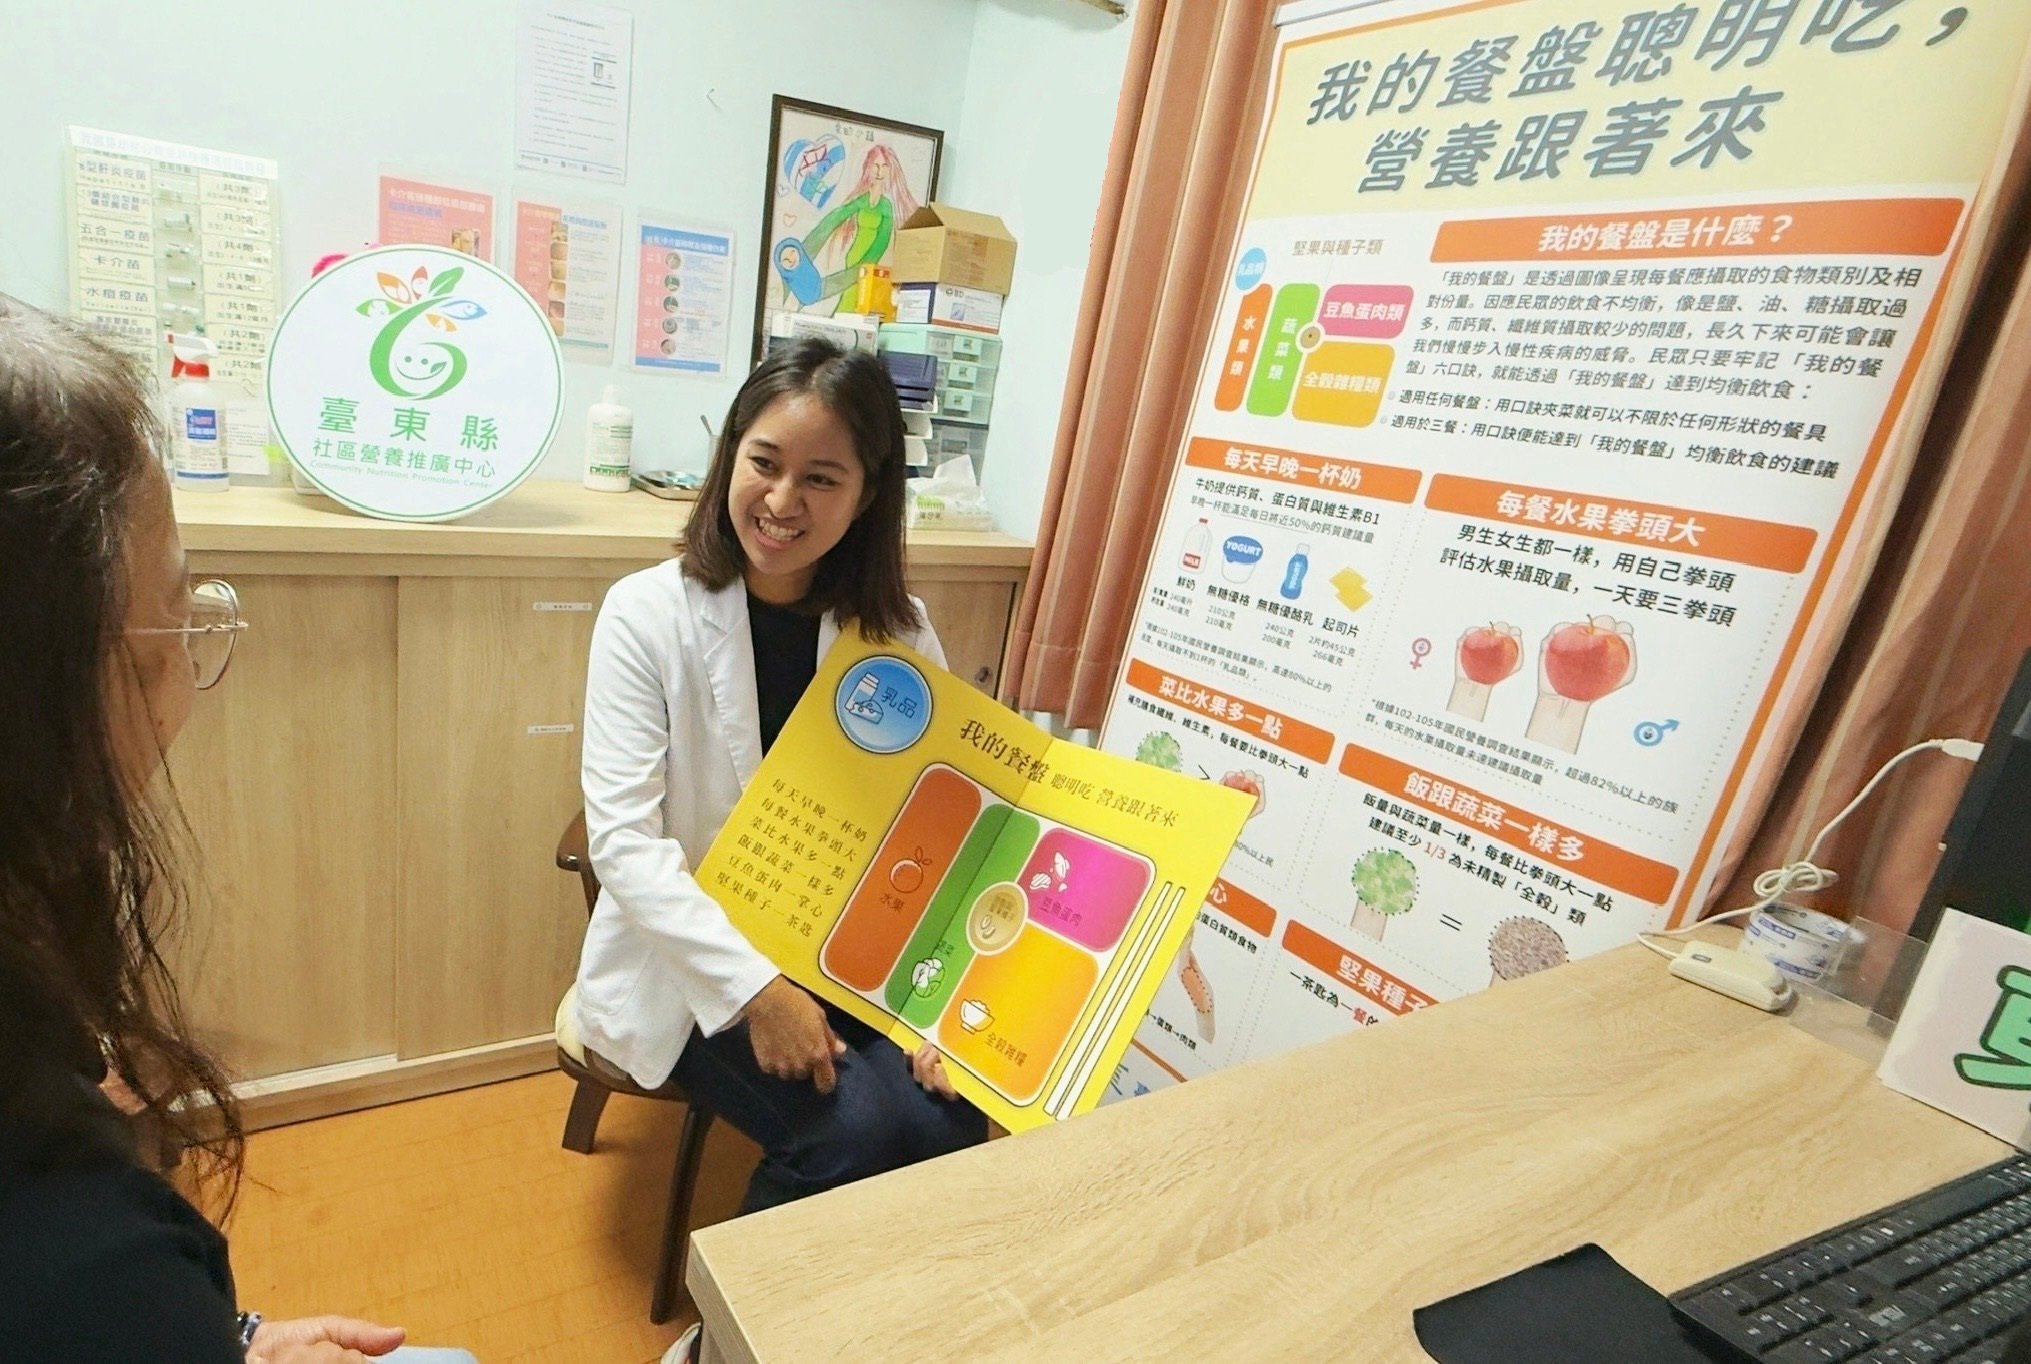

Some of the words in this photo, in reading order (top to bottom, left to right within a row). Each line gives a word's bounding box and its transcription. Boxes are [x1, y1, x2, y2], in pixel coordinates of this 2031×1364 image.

[1306, 0, 1968, 127] 我的餐盤聰明吃，
[1357, 86, 1784, 195] 營養跟著來
[1292, 239, 1384, 257] 堅果與種子類
[1537, 213, 1793, 253] 我的餐盤是什麼？
[95, 255, 140, 270] 卡介苗
[1441, 265, 1923, 289] 「我的餐盤」是透過圖像呈現每餐應攝取的食物類別及相
[1323, 301, 1406, 322] 豆魚蛋肉類
[1425, 293, 1909, 319] 對份量。因應民眾的飲食不均衡，像是鹽、油、糖攝取過
[1229, 316, 1257, 377] 水果類
[1267, 318, 1299, 381] 蔬菜類
[1419, 315, 1899, 349] 多，而鈣質、纖維質攝取較少的問題，長久下來可能會讓
[1405, 359, 1813, 401] 盤」六口訣，就能透過「我的餐盤」達到均衡飲食：
[1412, 338, 1885, 379] 我們慢慢步入慢性疾病的威脅。民眾只要牢記「我的餐
[1302, 371, 1382, 395] 全穀雜糧類
[318, 396, 499, 451] 臺東縣
[1399, 388, 1828, 443] 適用任何餐盤：用口訣夾菜就可以不限於任何形狀的餐具
[312, 437, 496, 479] 社區營養推廣中心
[1224, 446, 1362, 490] 每天早晚一杯奶
[1390, 413, 1841, 480] 適用於三餐：用口訣便能達到「我的餐盤」均衡飲食的建議
[310, 460, 363, 475] Community
[367, 467, 409, 480] Nutrition
[412, 472, 460, 485] Promotion
[463, 478, 493, 490] Center
[1496, 489, 1706, 548] 每餐水果拳頭大
[1226, 541, 1262, 557] YOGURT
[1458, 523, 1737, 594] 男生女生都一樣，用自己拳頭
[1176, 575, 1196, 591] 鮮奶
[1207, 584, 1250, 607] 無糖優格
[1439, 546, 1737, 628] 評估水果攝取量，一天要三拳頭
[1256, 598, 1314, 626] 無糖優酪乳
[1321, 617, 1360, 638] 起司片
[881, 687, 918, 719] 乳品
[1158, 675, 1284, 741] 菜比水果多一點
[960, 718, 1050, 785] 我的餐盤
[1050, 773, 1096, 801] 聰明吃
[1096, 787, 1180, 828] 營養跟著來
[760, 797, 858, 863] 每餐水果拳頭大
[771, 777, 869, 843] 每天早晚一杯奶
[1403, 770, 1585, 863] 飯跟蔬菜一樣多
[750, 815, 847, 881] 菜比水果多一點
[1362, 792, 1614, 912] 飯量與蔬菜量一樣，每餐比拳頭大一點
[1368, 816, 1422, 847] 建議至少
[1423, 840, 1446, 861] 1/3
[728, 854, 824, 918] 豆魚蛋肉一掌心
[737, 833, 835, 896] 飯跟蔬菜一樣多
[716, 871, 814, 938] 堅果種子一茶匙
[880, 893, 906, 914] 水果
